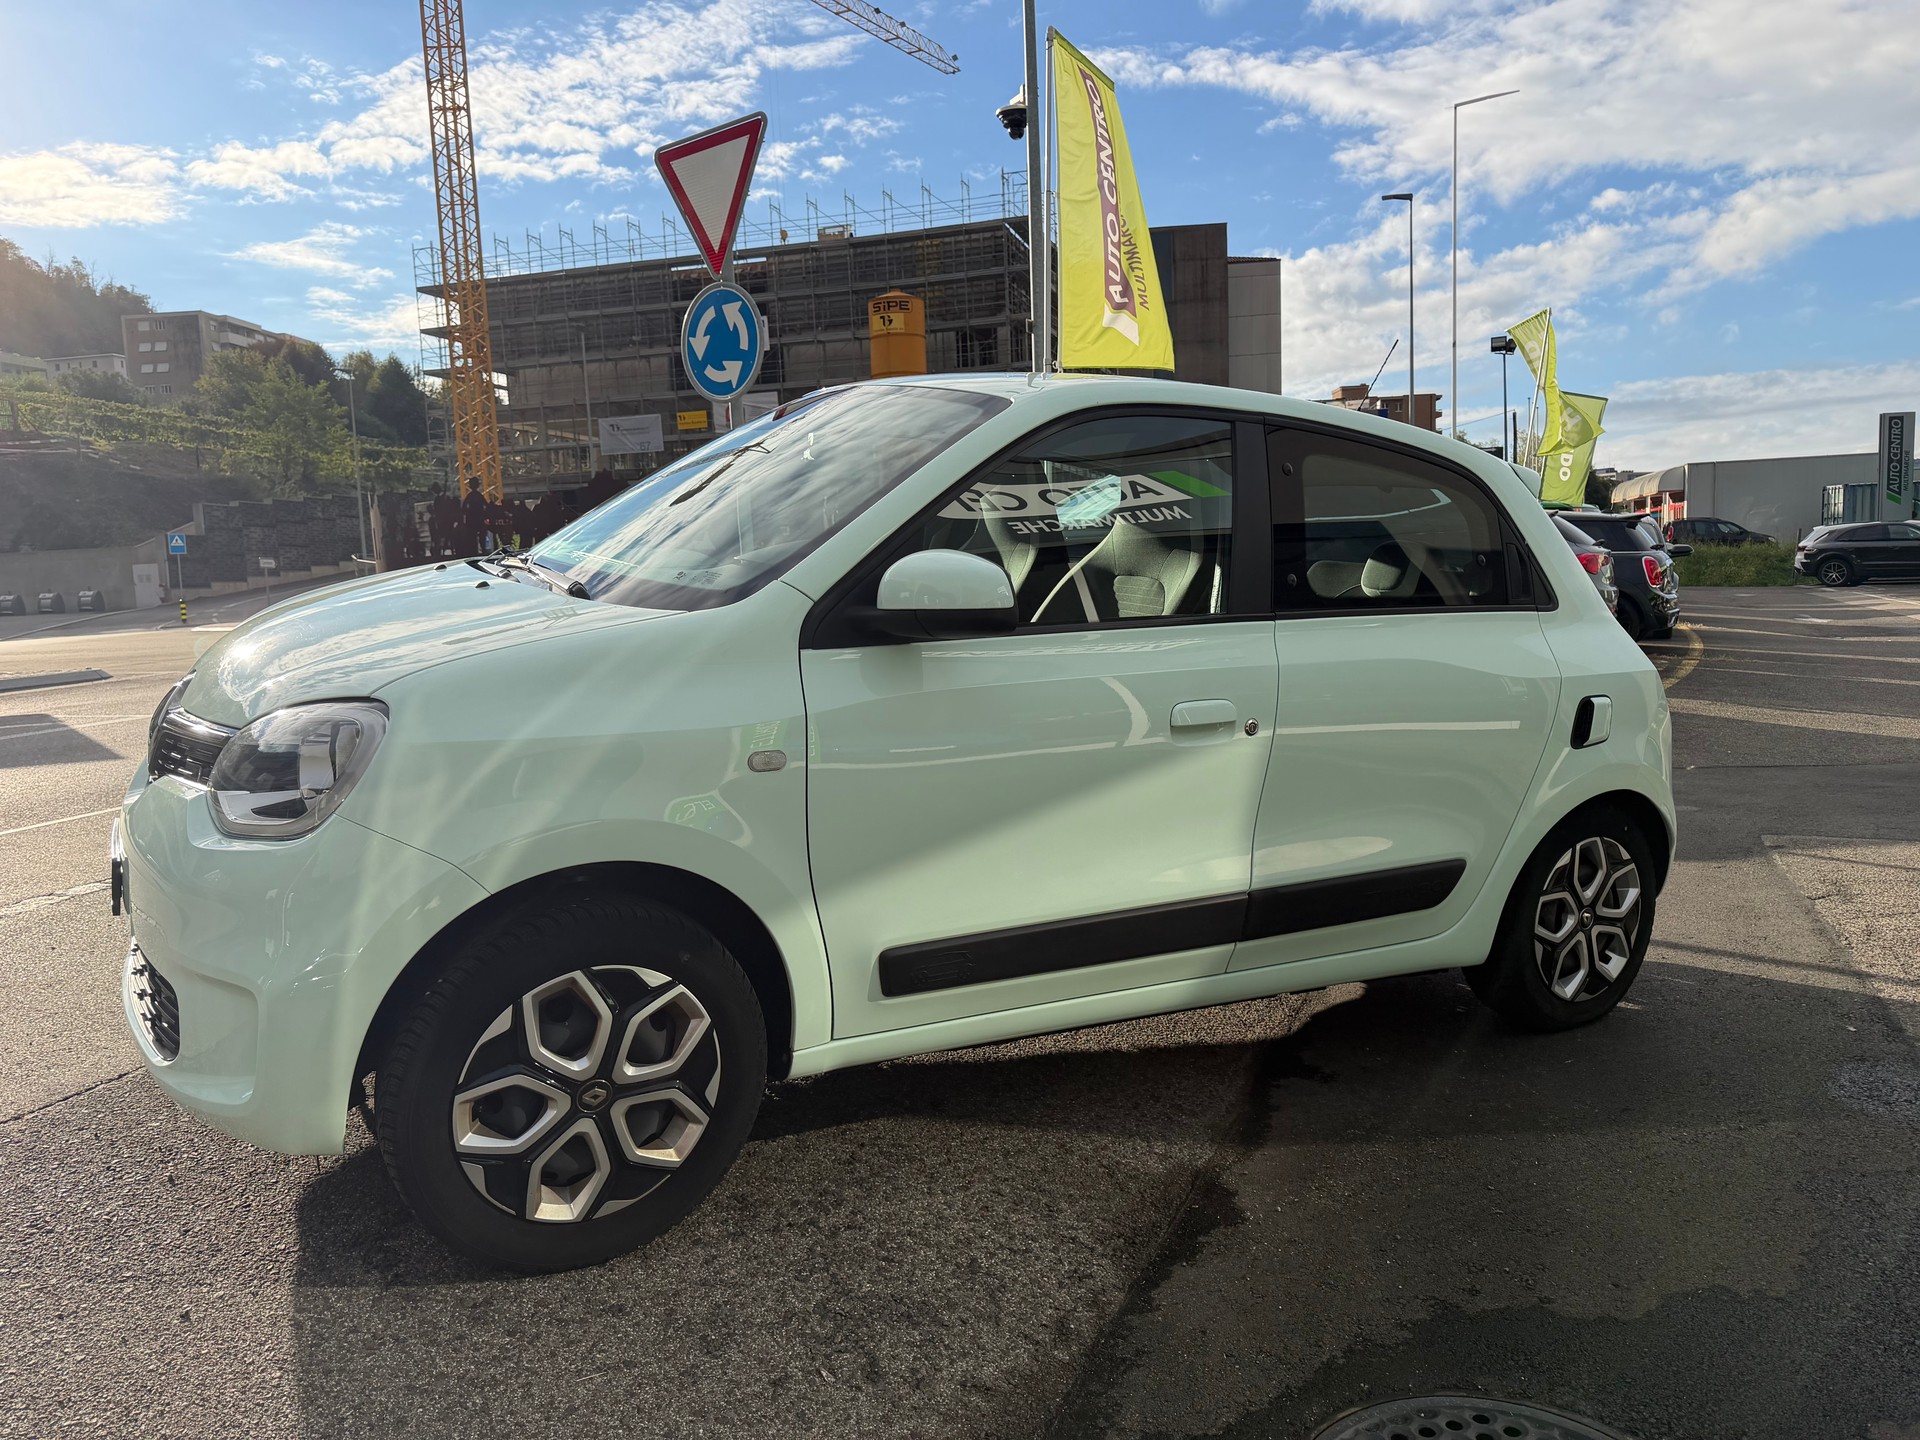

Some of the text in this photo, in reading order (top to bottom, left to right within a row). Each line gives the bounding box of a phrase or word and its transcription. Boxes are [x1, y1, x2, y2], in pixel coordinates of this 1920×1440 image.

[1085, 78, 1130, 303] AUTO CENTRO
[1120, 214, 1150, 311] MULTIMARC
[1888, 419, 1902, 492] AUTO CENTRO
